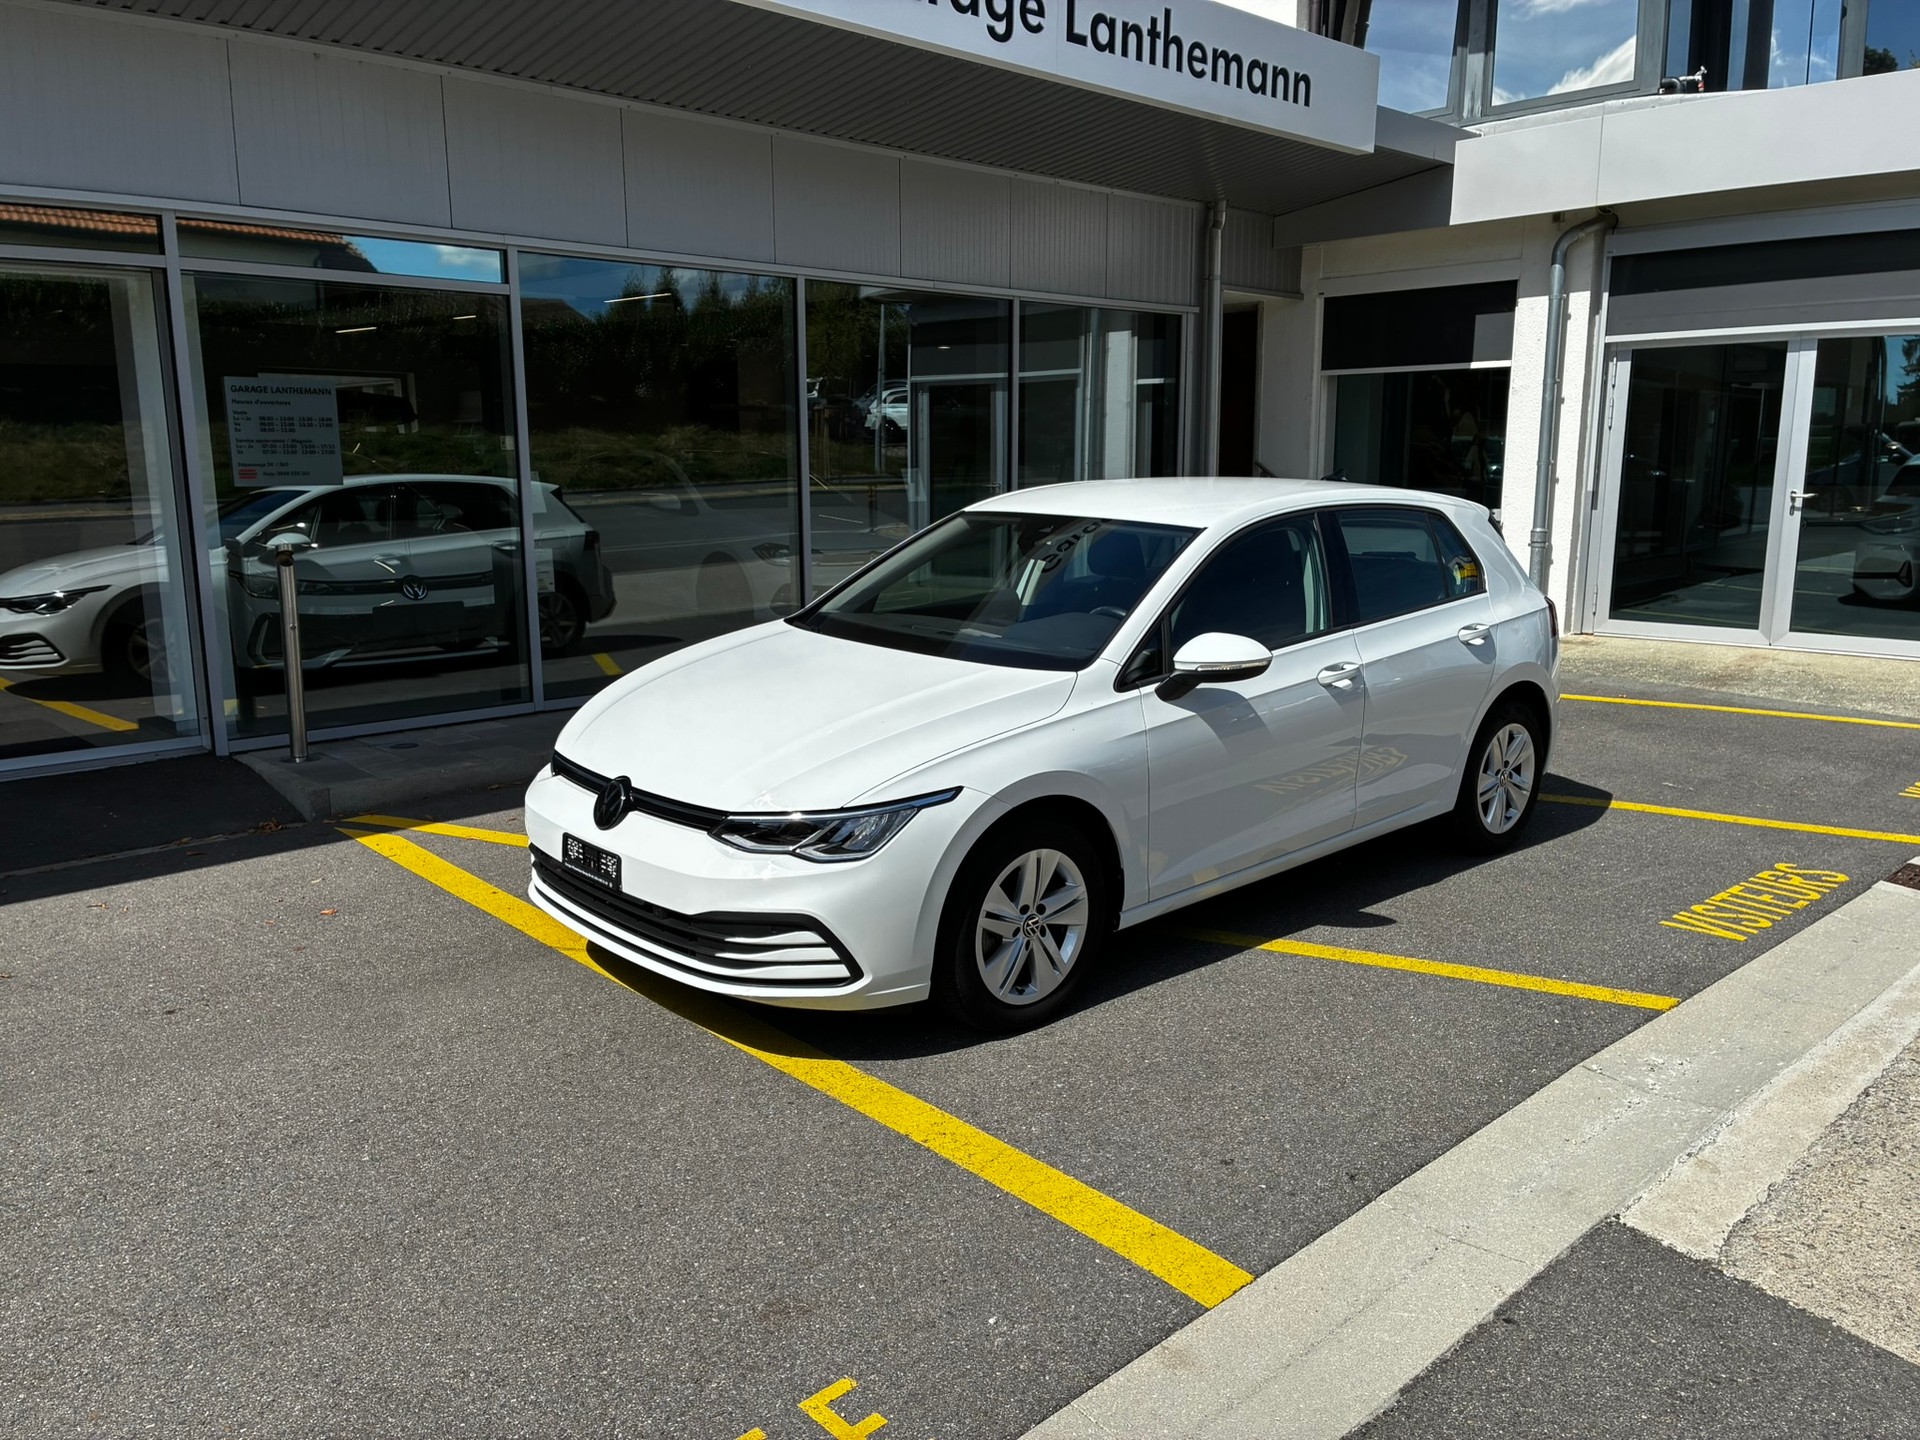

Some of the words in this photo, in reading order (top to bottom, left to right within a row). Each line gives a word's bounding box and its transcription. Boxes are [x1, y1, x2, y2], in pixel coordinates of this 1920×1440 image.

[1066, 0, 1312, 108] Lanthemann
[230, 384, 269, 394] GARAGE
[270, 386, 332, 396] LANTHEMANN
[1659, 862, 1850, 942] VISITEURS
